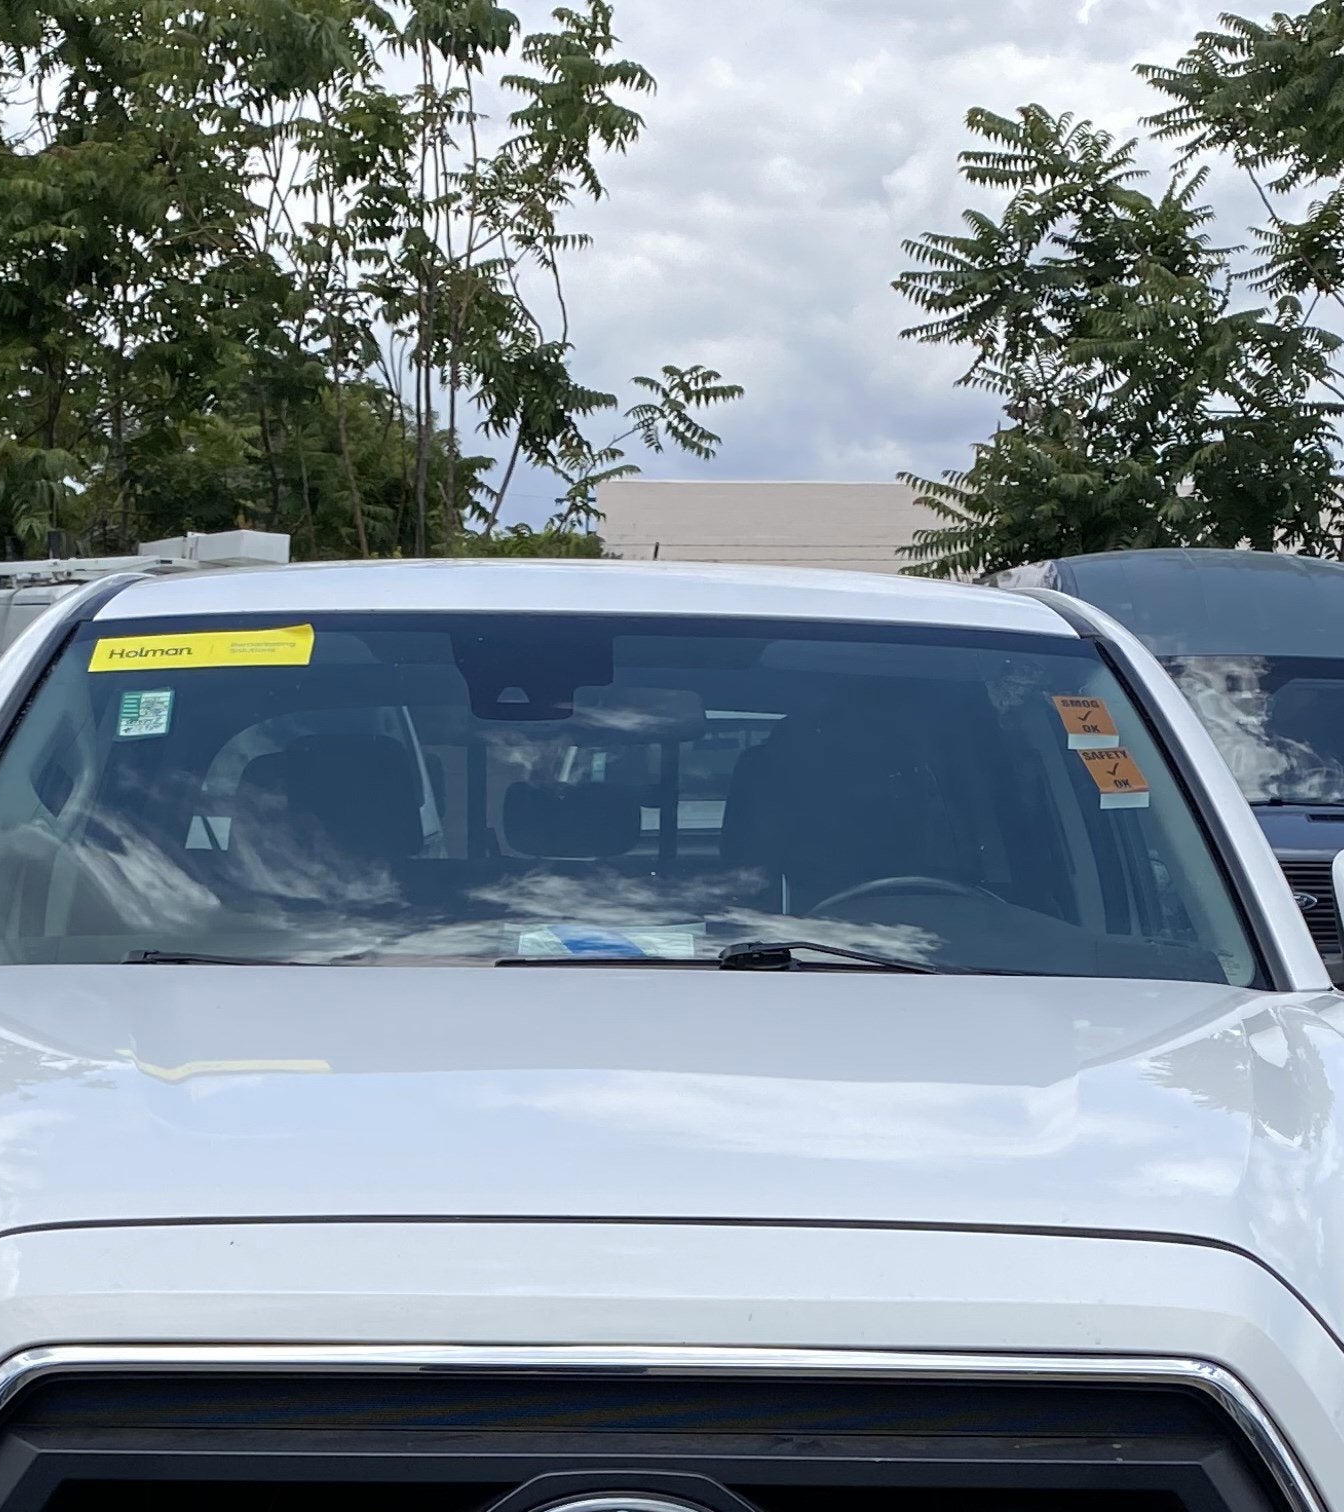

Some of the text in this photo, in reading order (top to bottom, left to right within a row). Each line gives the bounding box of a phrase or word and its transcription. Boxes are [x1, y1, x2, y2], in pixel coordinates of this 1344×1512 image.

[108, 647, 192, 659] Holman
[1061, 700, 1100, 708] SMOG
[1082, 725, 1101, 733] OK
[1081, 750, 1128, 760] SAFETY
[1114, 779, 1131, 788] OK
